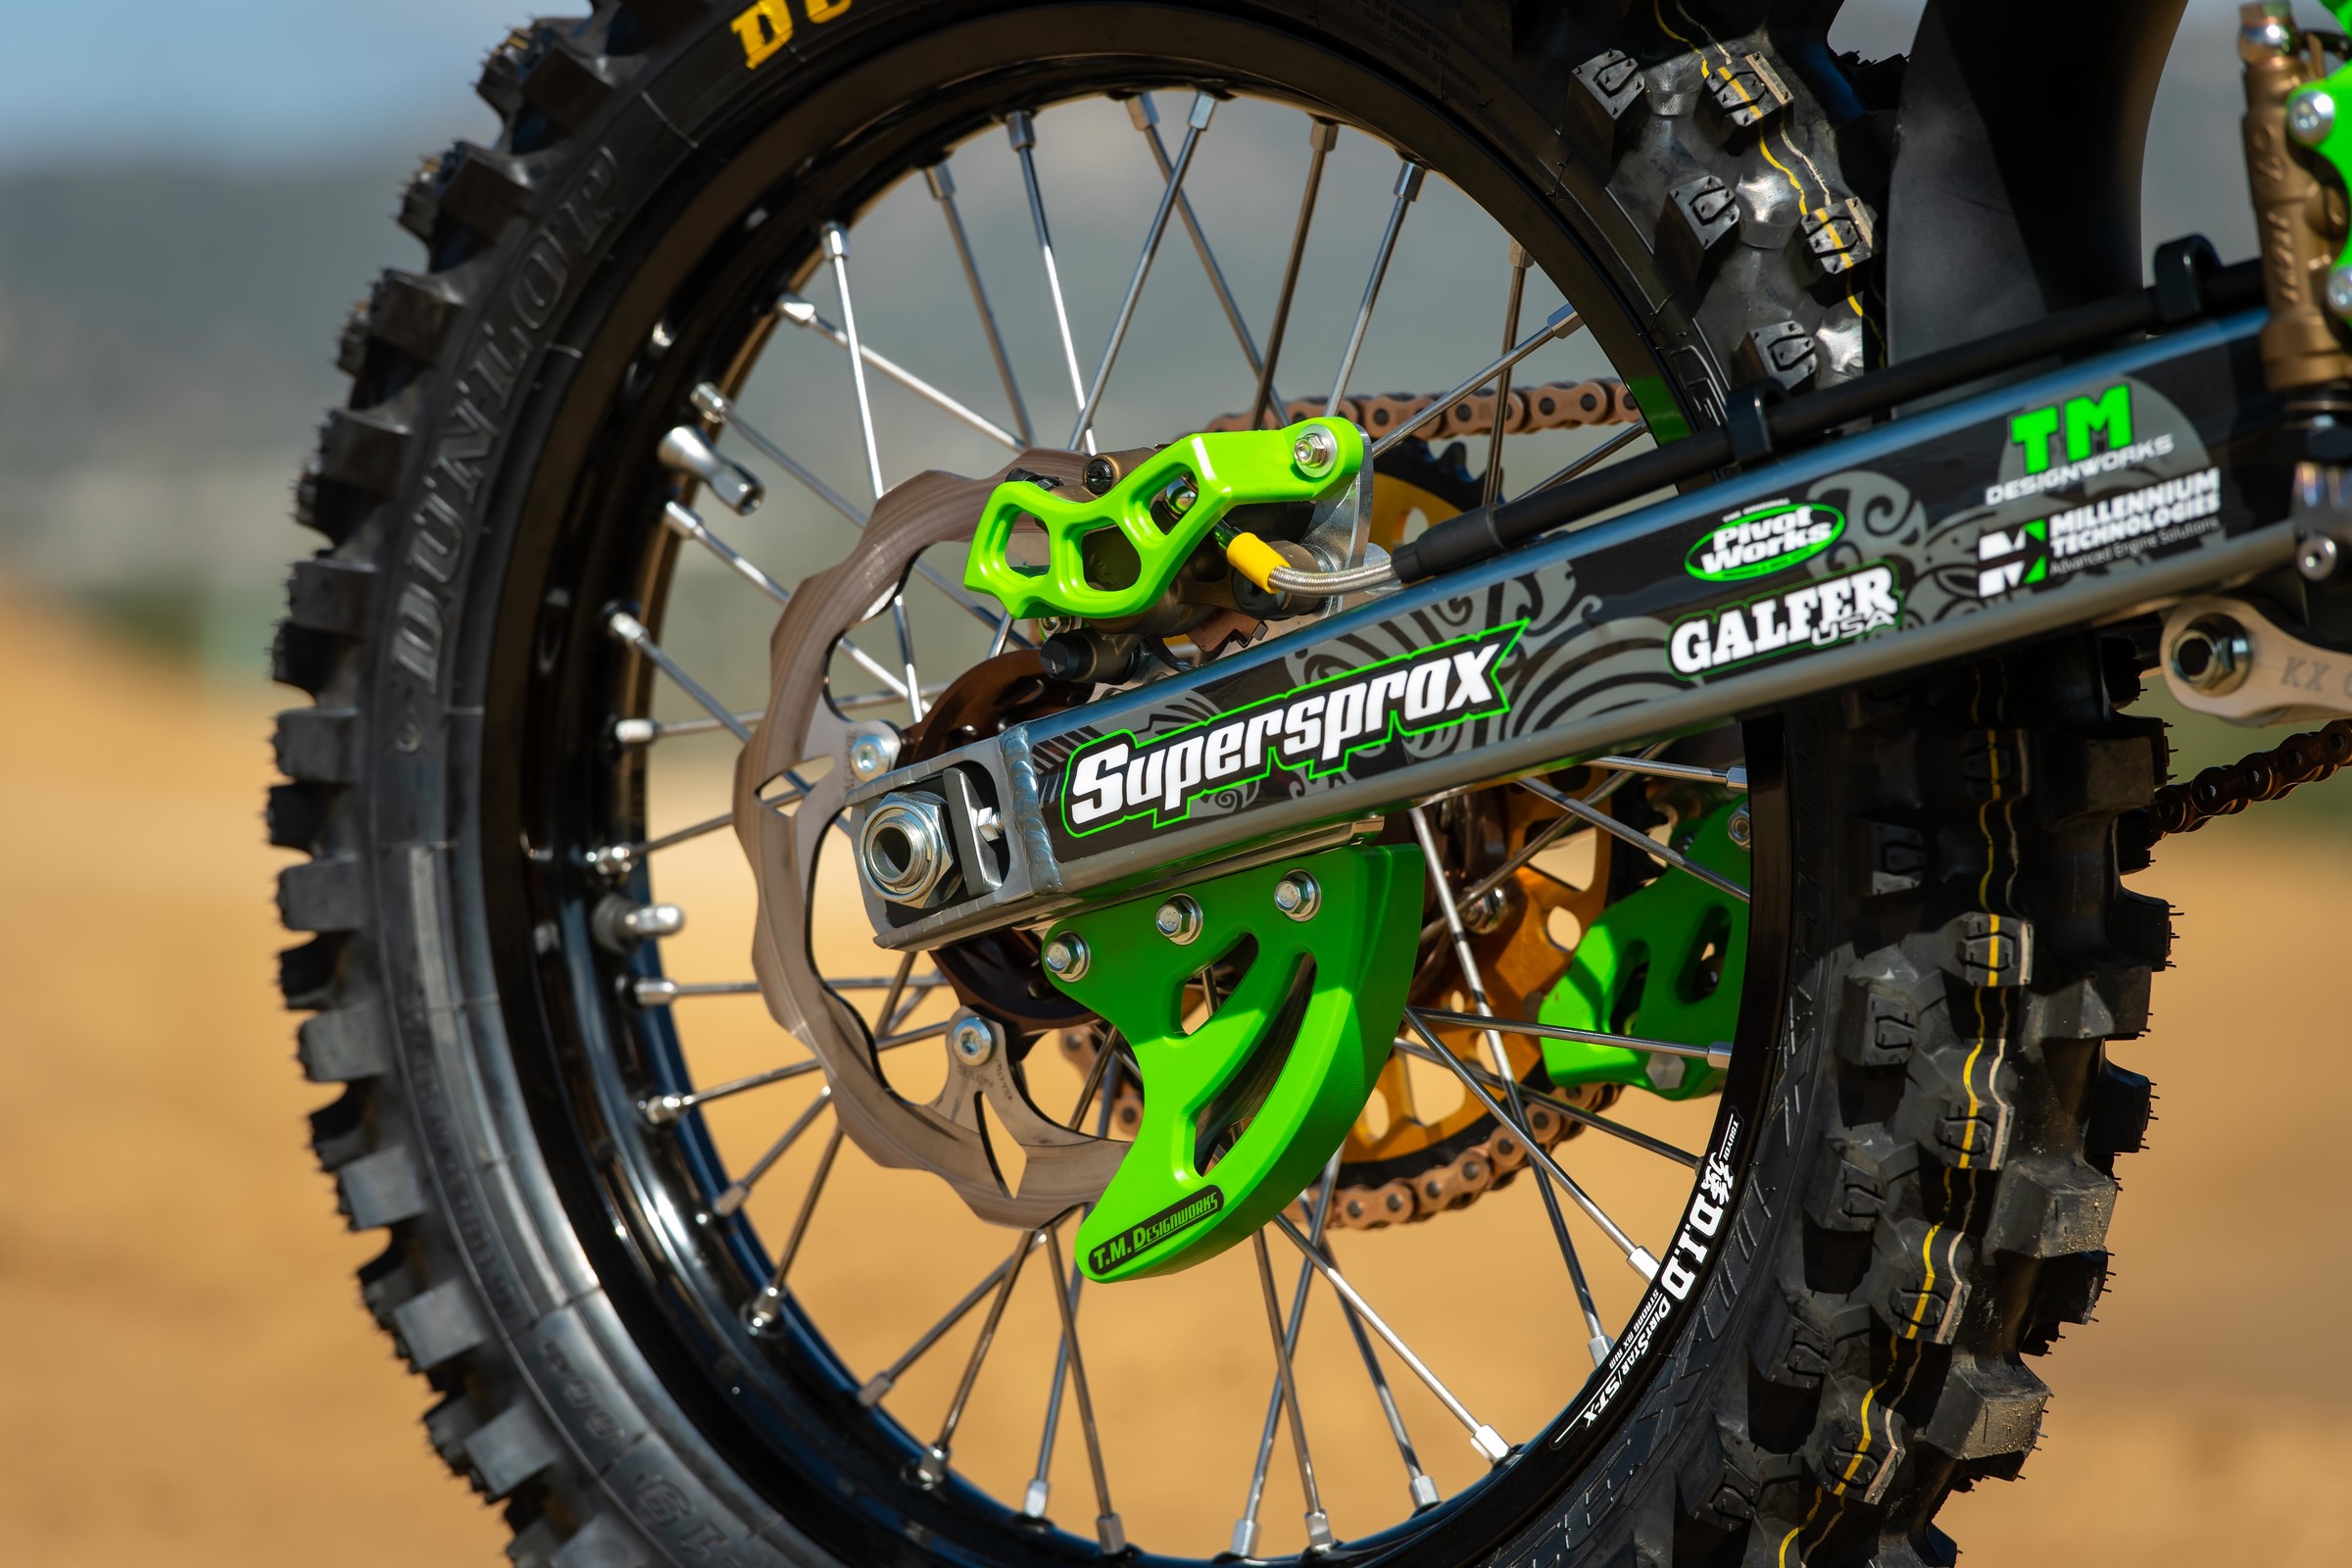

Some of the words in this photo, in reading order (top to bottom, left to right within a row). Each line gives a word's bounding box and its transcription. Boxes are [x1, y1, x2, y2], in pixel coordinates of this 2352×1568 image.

[391, 143, 621, 692] DUNLOP
[2011, 383, 2133, 474] TM
[1986, 434, 2175, 506] DESIGNWORKS
[2049, 466, 2221, 538] MILLENNIUM
[1700, 521, 1833, 574] Works
[1713, 506, 1813, 552] Pivot
[2049, 546, 2108, 576] Advanced
[2113, 533, 2157, 560] Engine
[2160, 516, 2220, 546] Solutions
[2051, 492, 2221, 558] TECHNOLOGIES
[1670, 566, 1898, 673] GALFER
[1811, 611, 1895, 647] USA
[2279, 657, 2331, 692] KX
[1071, 643, 1500, 825] Supersprox
[1093, 1237, 1132, 1270] T.M.
[1661, 1193, 1724, 1300] D.I.D
[1633, 1288, 1660, 1334] STRONG
